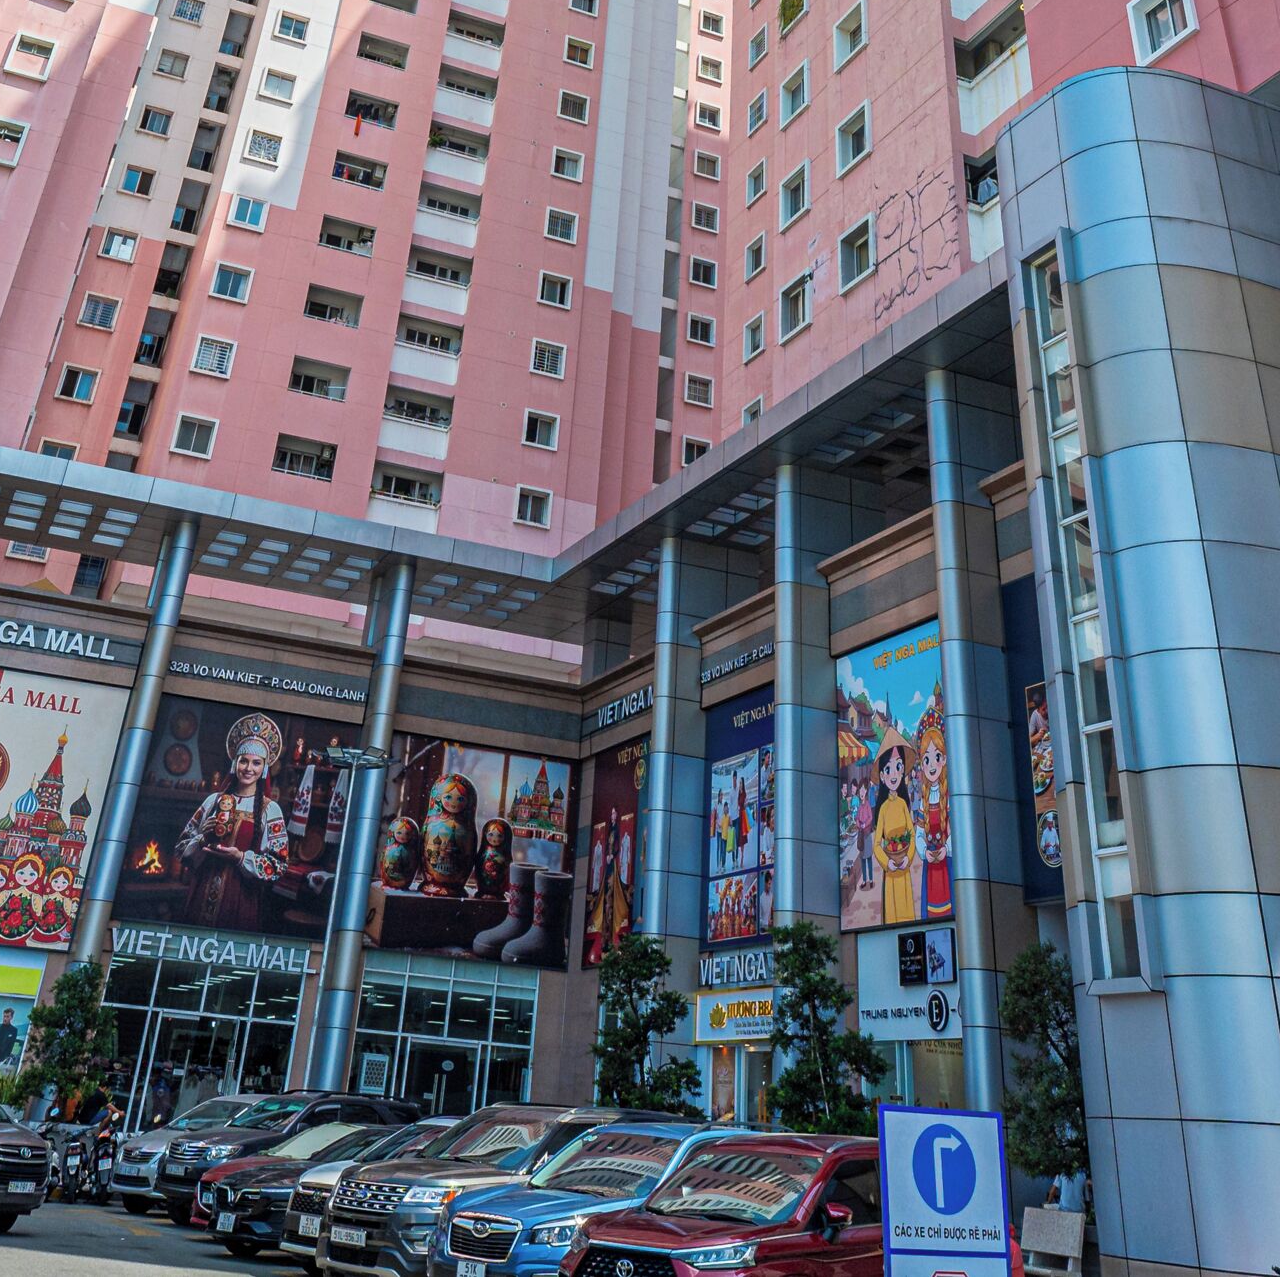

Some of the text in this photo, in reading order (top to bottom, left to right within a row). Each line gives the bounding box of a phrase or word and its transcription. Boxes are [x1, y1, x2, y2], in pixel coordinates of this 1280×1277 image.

[43, 628, 115, 661] MALL
[895, 643, 916, 662] NGA
[711, 666, 720, 679] VO
[720, 660, 733, 675] VAN
[734, 653, 748, 668] KIET
[758, 642, 772, 658] CAU
[170, 660, 189, 673] 328
[192, 664, 208, 676] VO
[211, 667, 235, 681] VAN
[236, 671, 263, 685] KIET
[282, 679, 306, 692] CAU
[308, 683, 333, 697] ONG
[335, 687, 365, 702] LANH
[24, 689, 82, 715] MALL
[598, 700, 621, 727] VIET
[621, 689, 645, 719] NGA
[750, 705, 766, 722] NGA
[112, 927, 317, 975] VIET NGA MALL
[700, 952, 767, 985] VIET NGA
[861, 1008, 889, 1020] TRUNG
[894, 1223, 912, 1237] CÁC
[914, 1226, 925, 1238] XE
[927, 1223, 942, 1239] CHỈ
[944, 1226, 967, 1241] ĐƯỢC
[982, 1225, 1001, 1241] PHẢI
[465, 1262, 478, 1275] 51K
